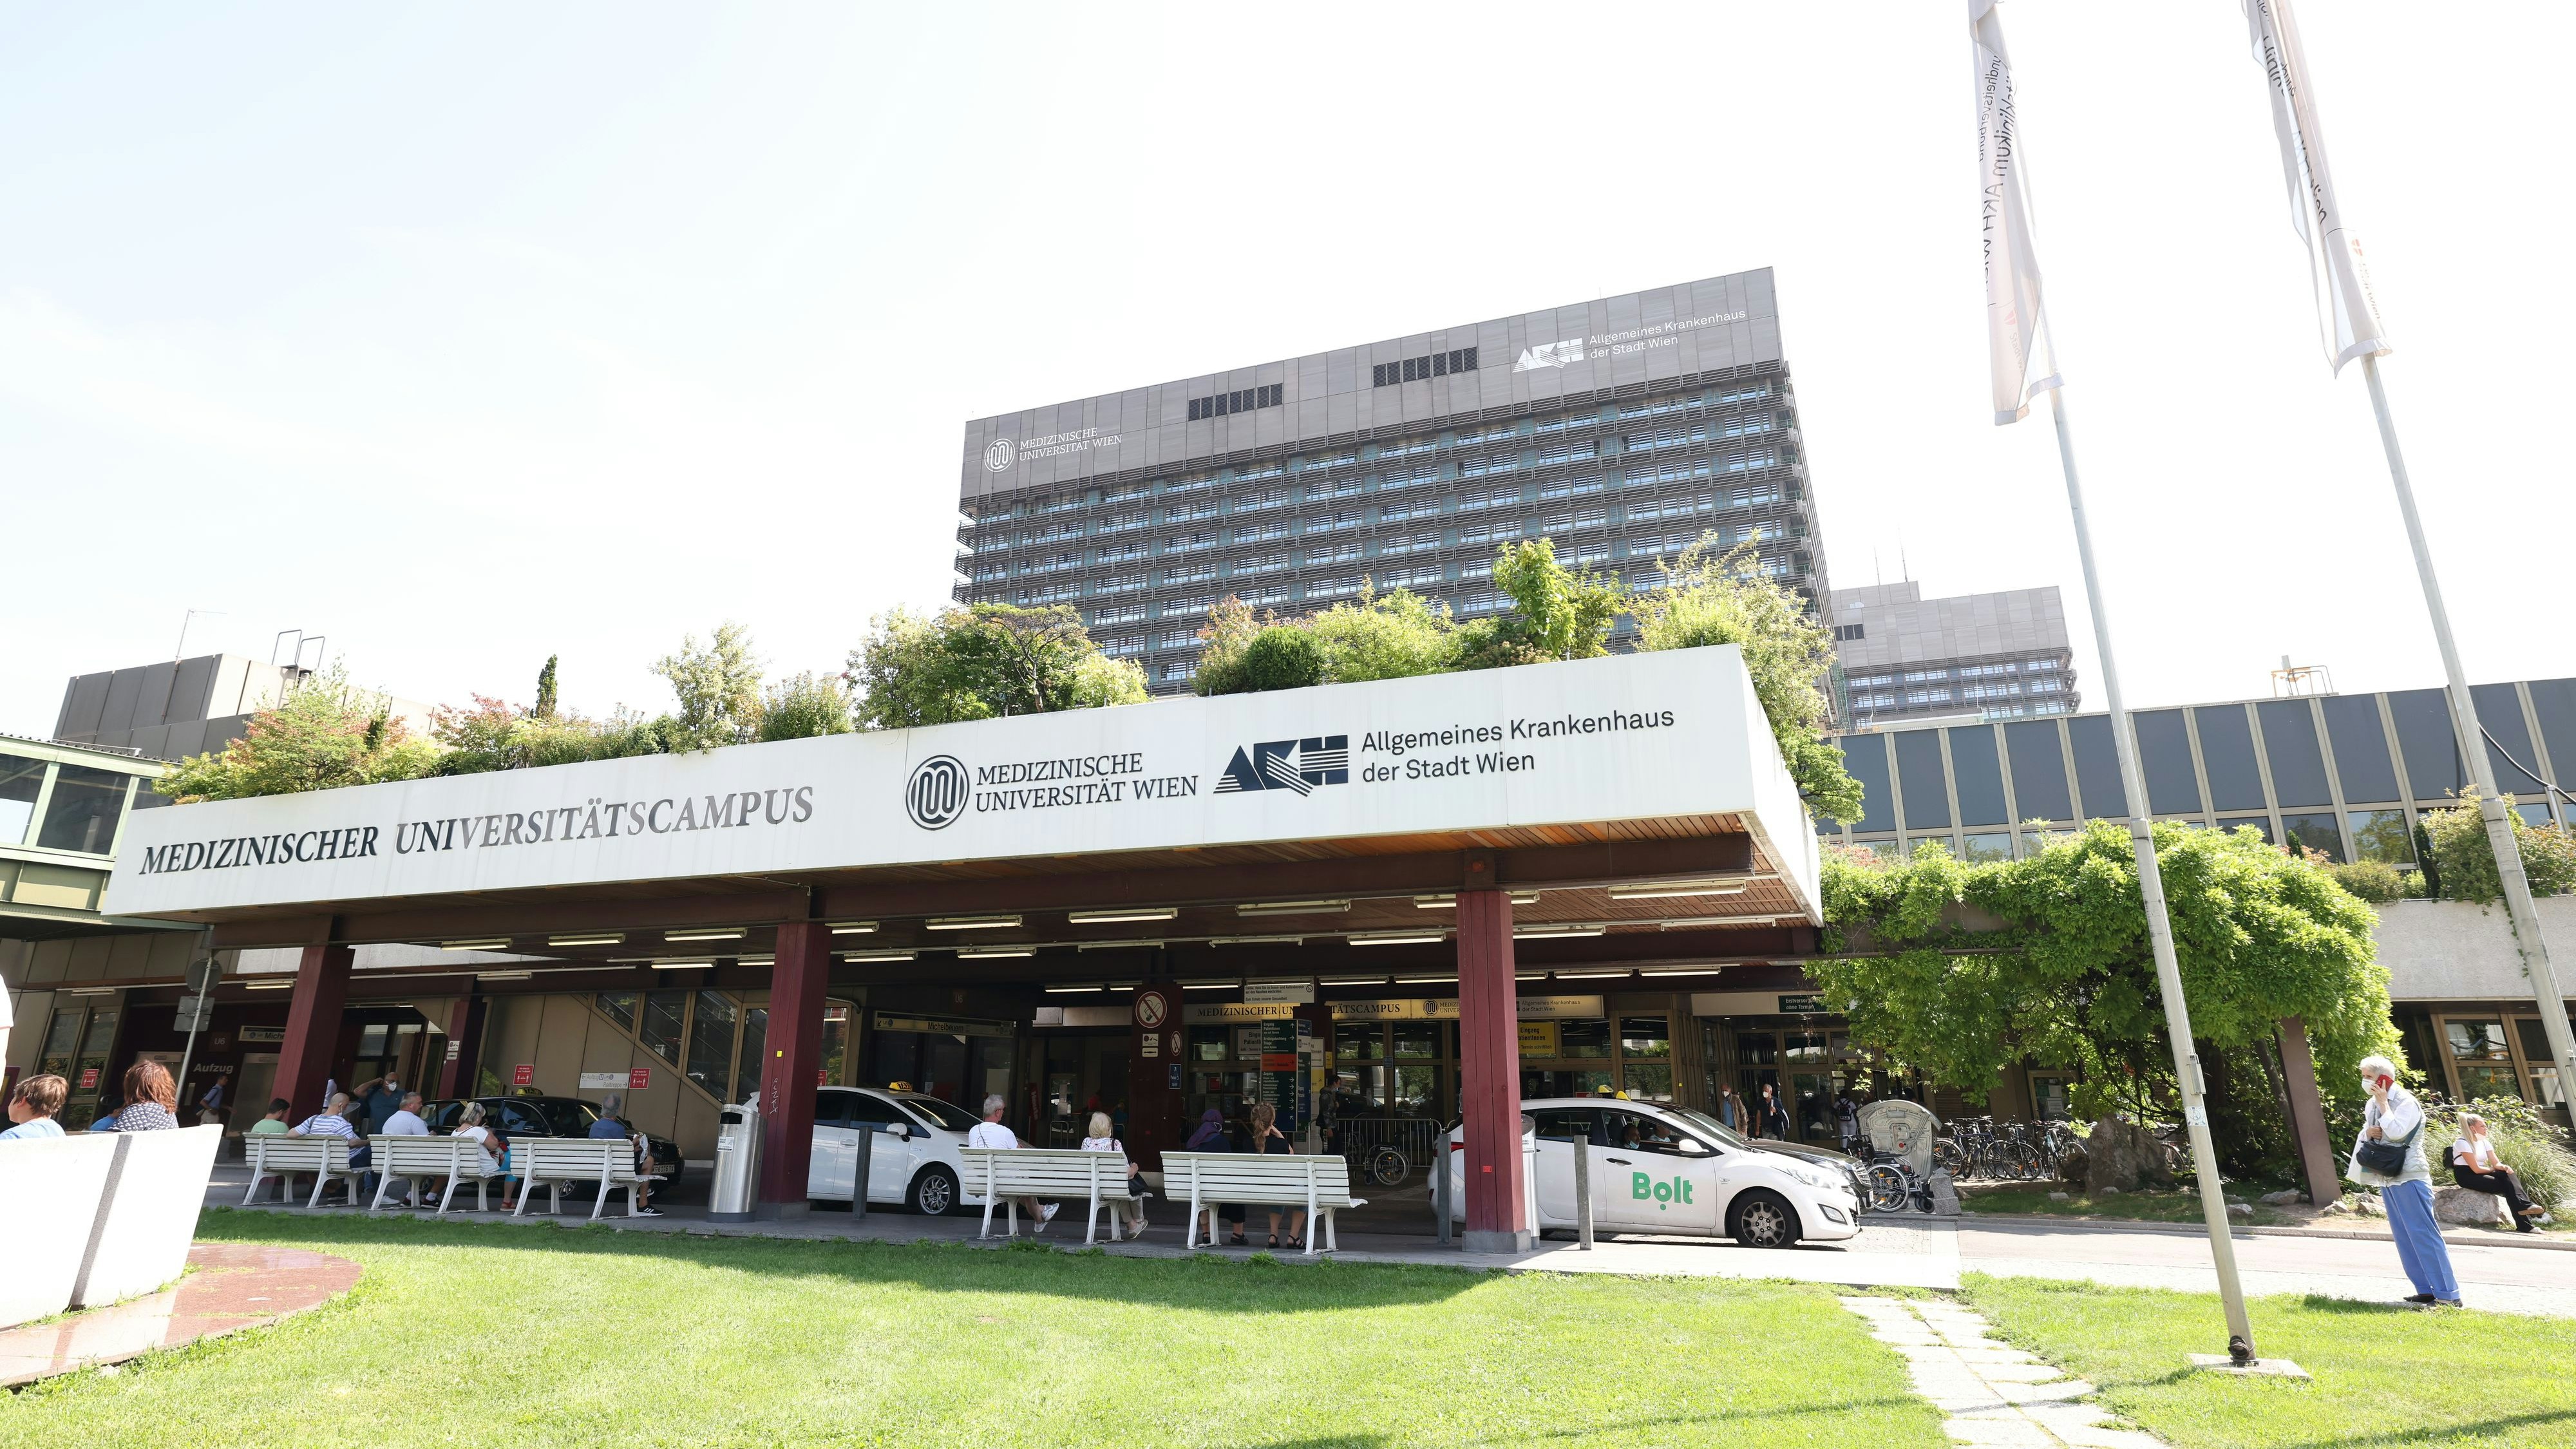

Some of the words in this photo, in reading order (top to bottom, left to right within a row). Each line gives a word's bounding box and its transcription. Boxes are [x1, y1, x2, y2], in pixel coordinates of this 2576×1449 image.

[1589, 326, 1662, 345] Allgemeines
[1665, 310, 1746, 331] Krankenhaus
[1591, 348, 1609, 359] der
[1613, 342, 1645, 355] Stadt
[1649, 336, 1678, 348] Wien
[1019, 428, 1097, 450] MEDIZINISCHE
[1019, 438, 1089, 461] UNIVERSITÄT
[1093, 435, 1122, 448] WIEN
[1361, 724, 1502, 755] Allgemeines
[1510, 710, 1674, 740] Krankenhaus
[977, 753, 1143, 786] MEDIZINISCHE
[1362, 759, 1397, 782] der
[1405, 755, 1470, 780] Stadt
[1476, 751, 1535, 774] Wien
[976, 778, 1126, 812] UNIVERSITÄT
[1133, 775, 1198, 800] WIEN
[139, 826, 379, 875] MEDIZINISCHER
[395, 786, 813, 855] UNIVERSITÄTSCAMPUS
[954, 994, 963, 1003] U6
[1197, 1007, 1278, 1017] MEDIZINISCHER
[927, 1021, 964, 1032] Michelbeuern
[193, 1063, 234, 1074] Aufzug
[1633, 1171, 1693, 1210] Bolt
